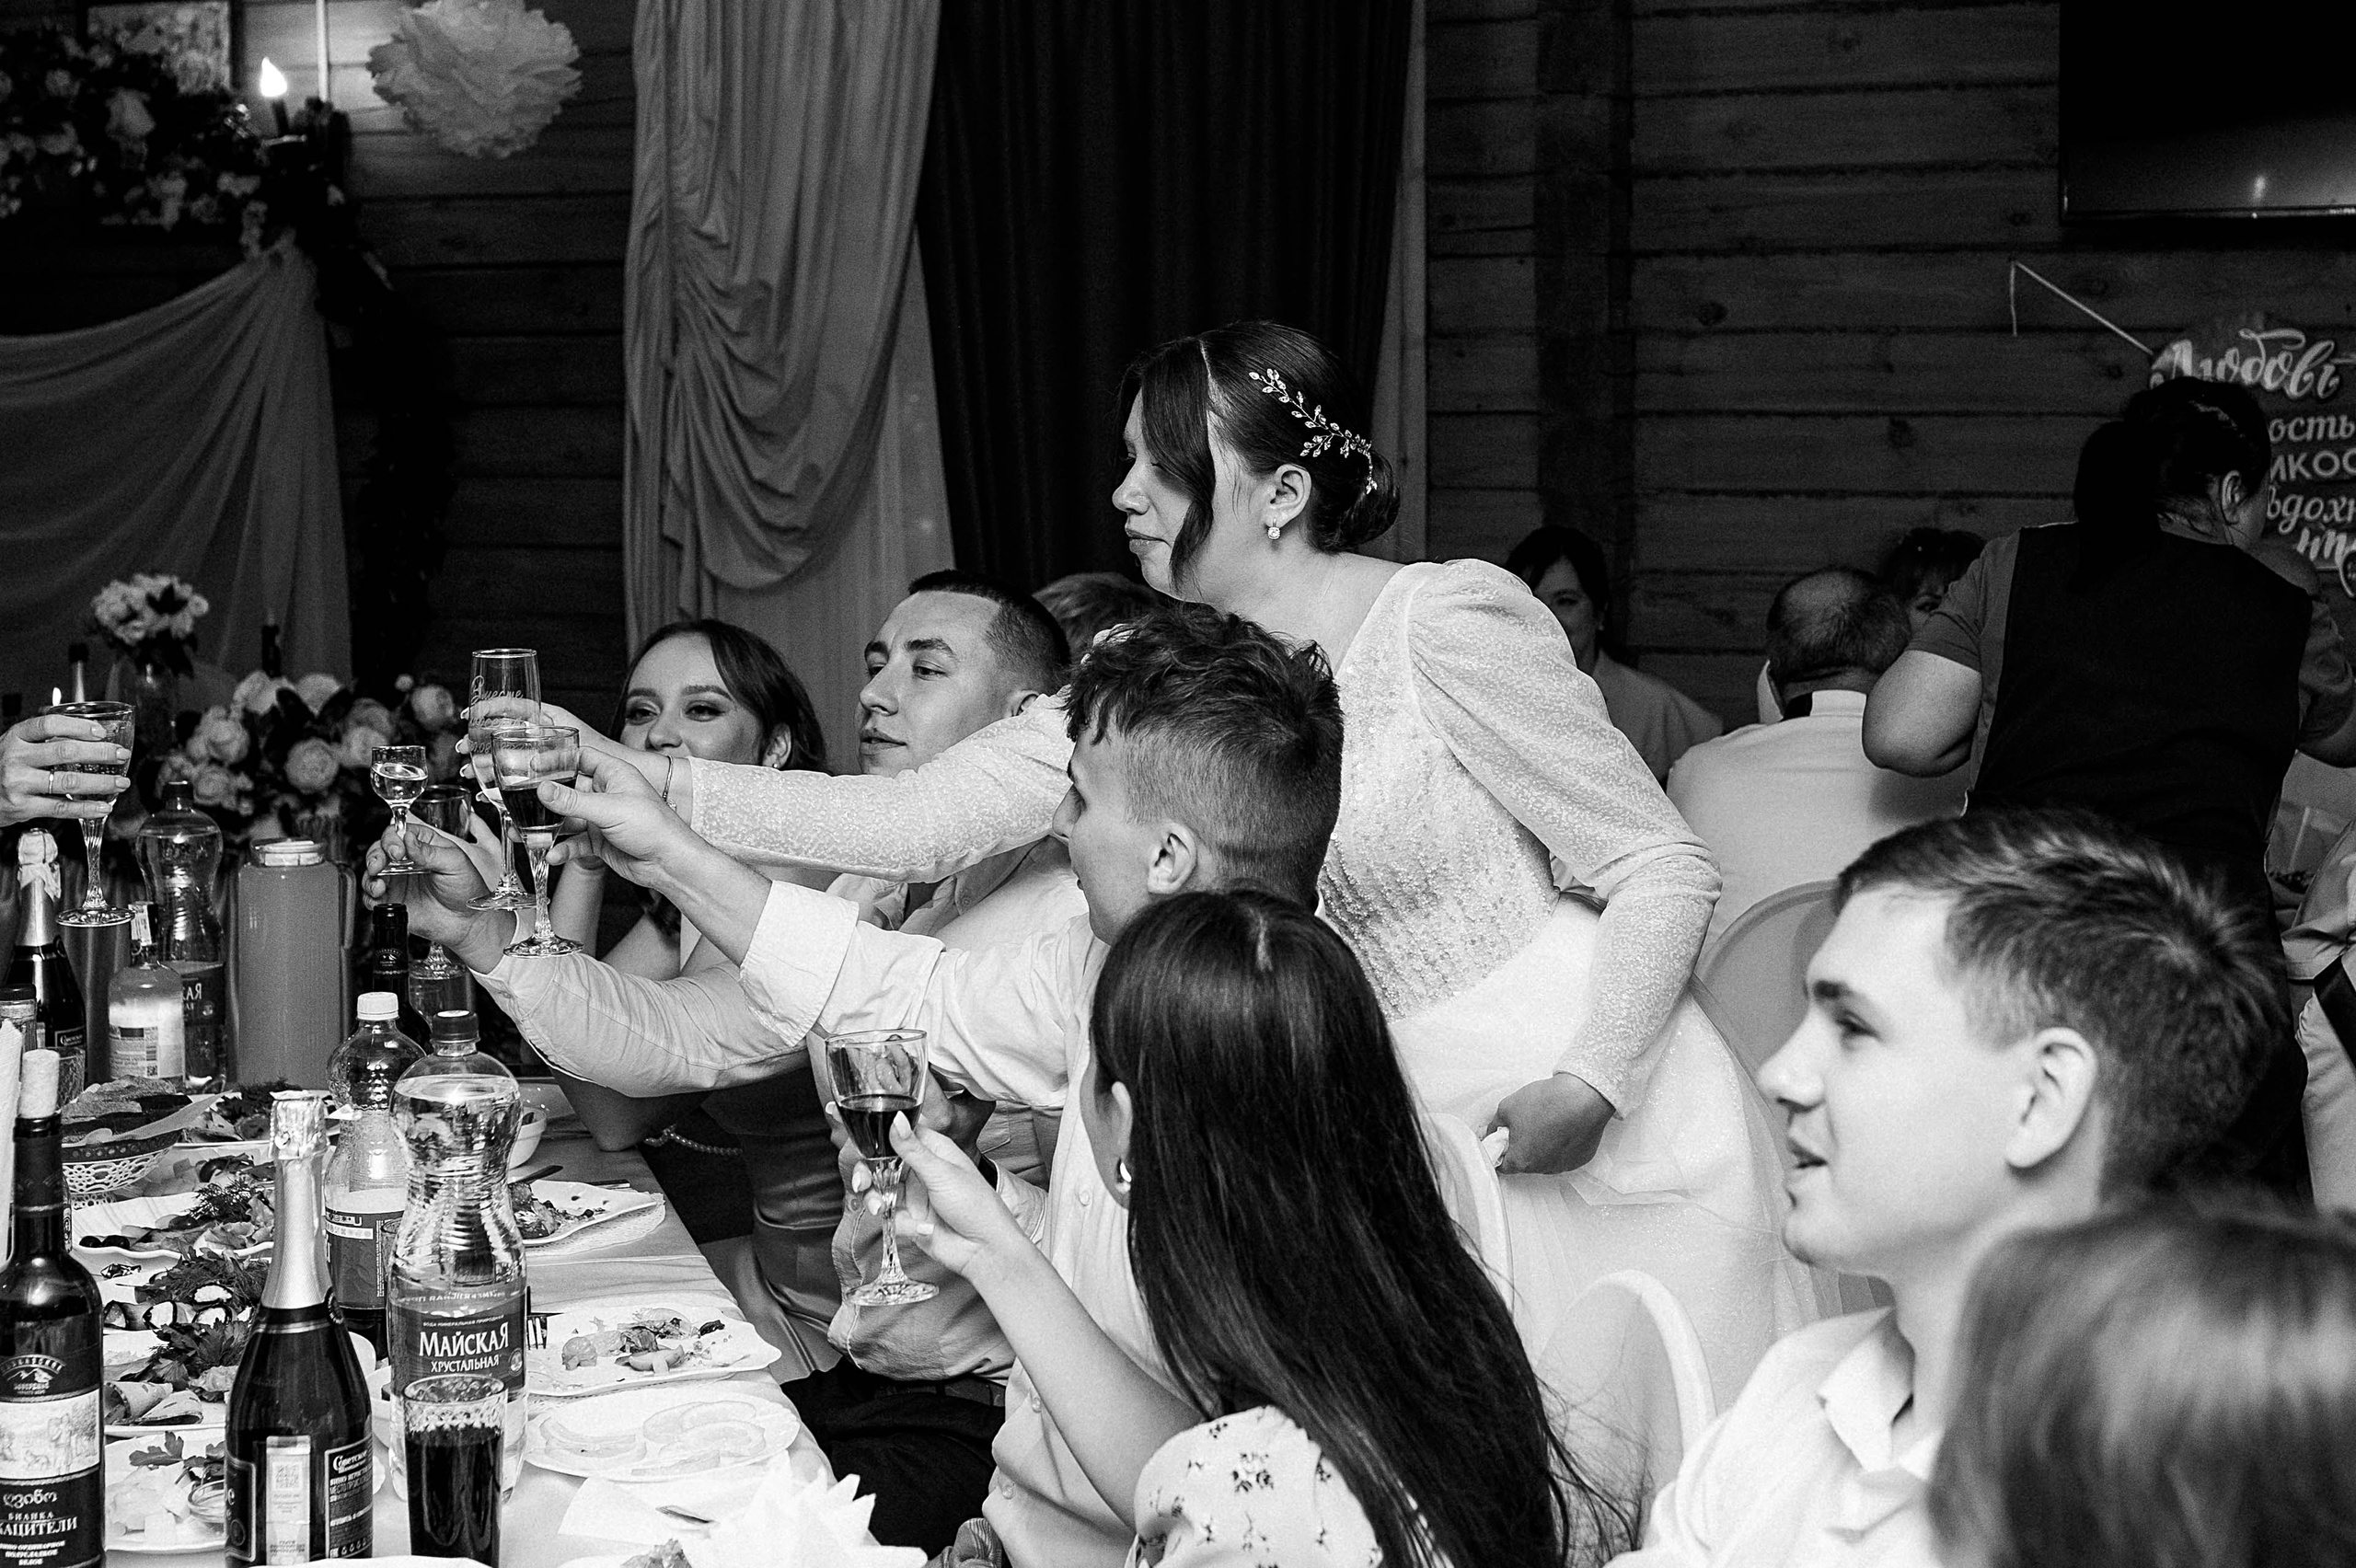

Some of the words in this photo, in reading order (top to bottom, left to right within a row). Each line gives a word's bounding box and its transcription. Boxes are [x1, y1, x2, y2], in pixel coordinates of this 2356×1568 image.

[2268, 414, 2356, 444] ость
[419, 1322, 509, 1357] МАЙСКАЯ
[431, 1355, 500, 1373] ХРУСТАЛЬНАЯ
